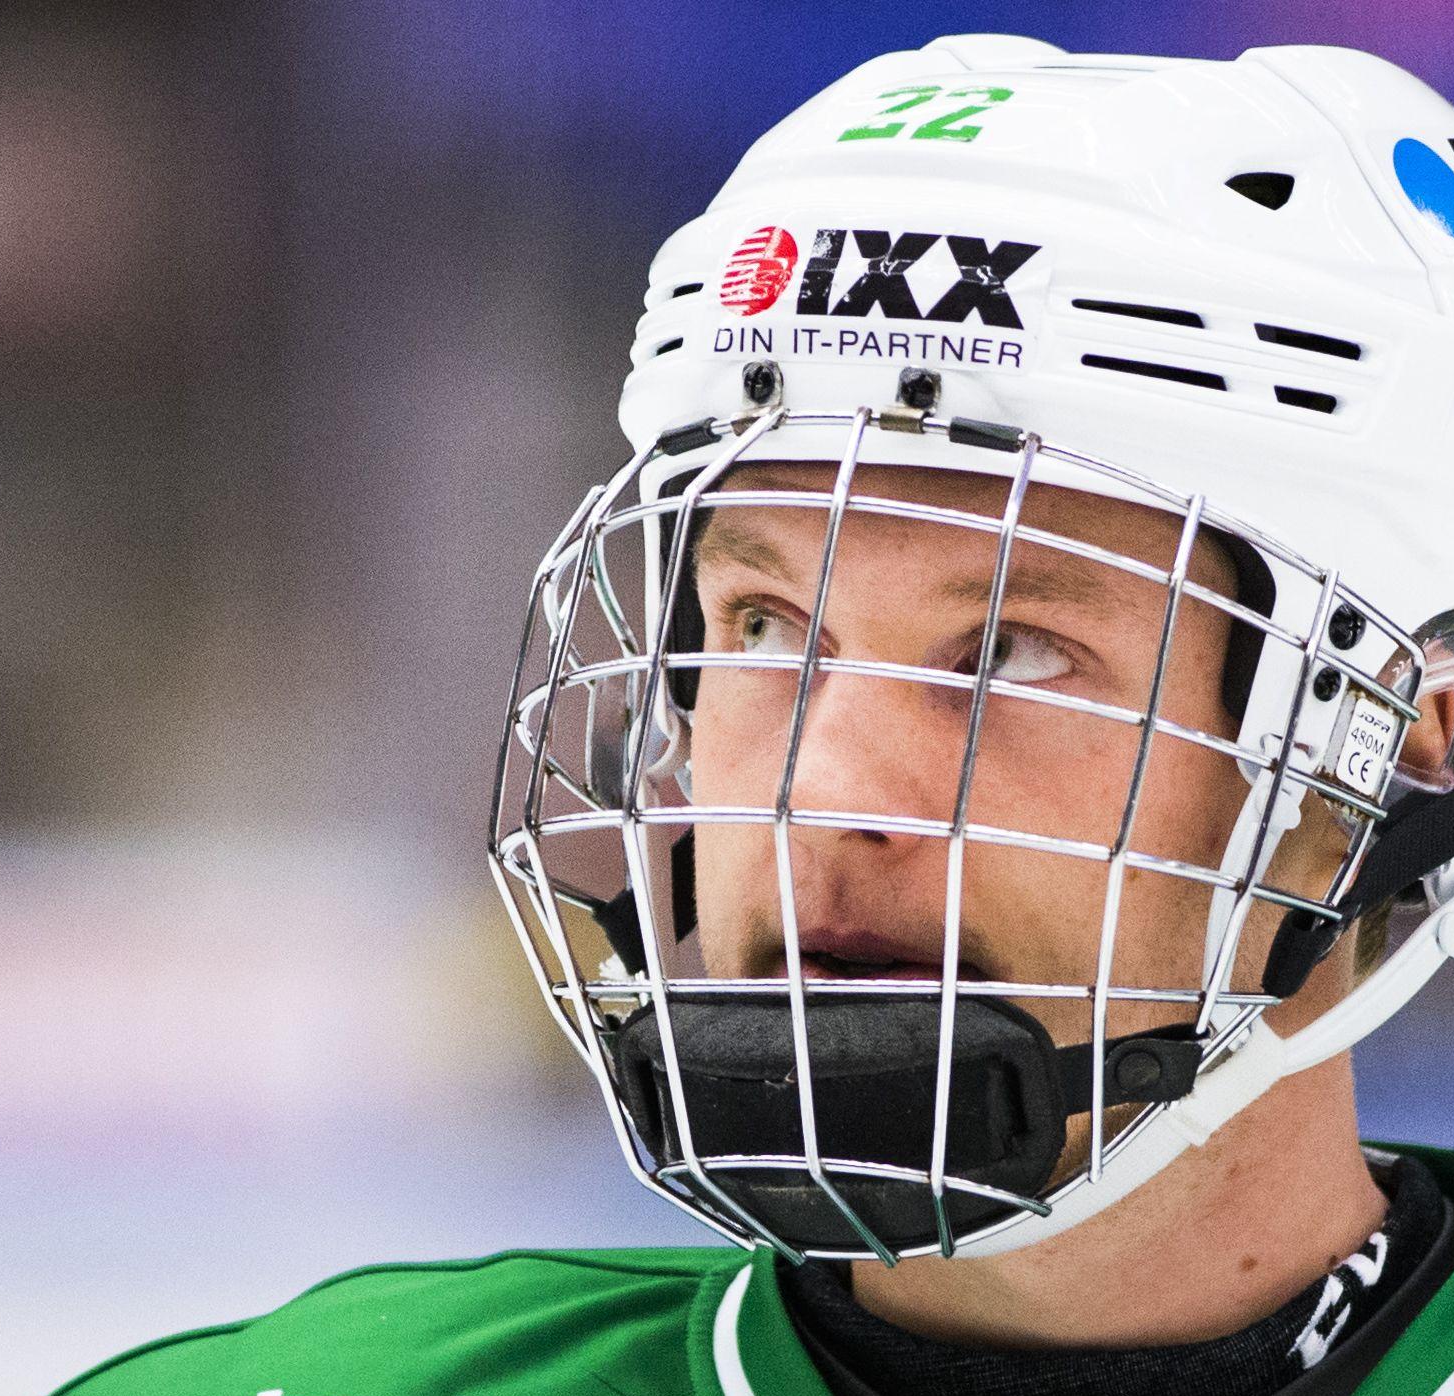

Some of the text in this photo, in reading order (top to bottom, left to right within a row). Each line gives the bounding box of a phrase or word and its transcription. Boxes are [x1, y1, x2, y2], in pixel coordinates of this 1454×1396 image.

[836, 86, 1015, 142] 22
[796, 229, 1042, 330] IXX
[713, 328, 1024, 368] DIN IT-PARTNER
[1350, 726, 1385, 757] 480M
